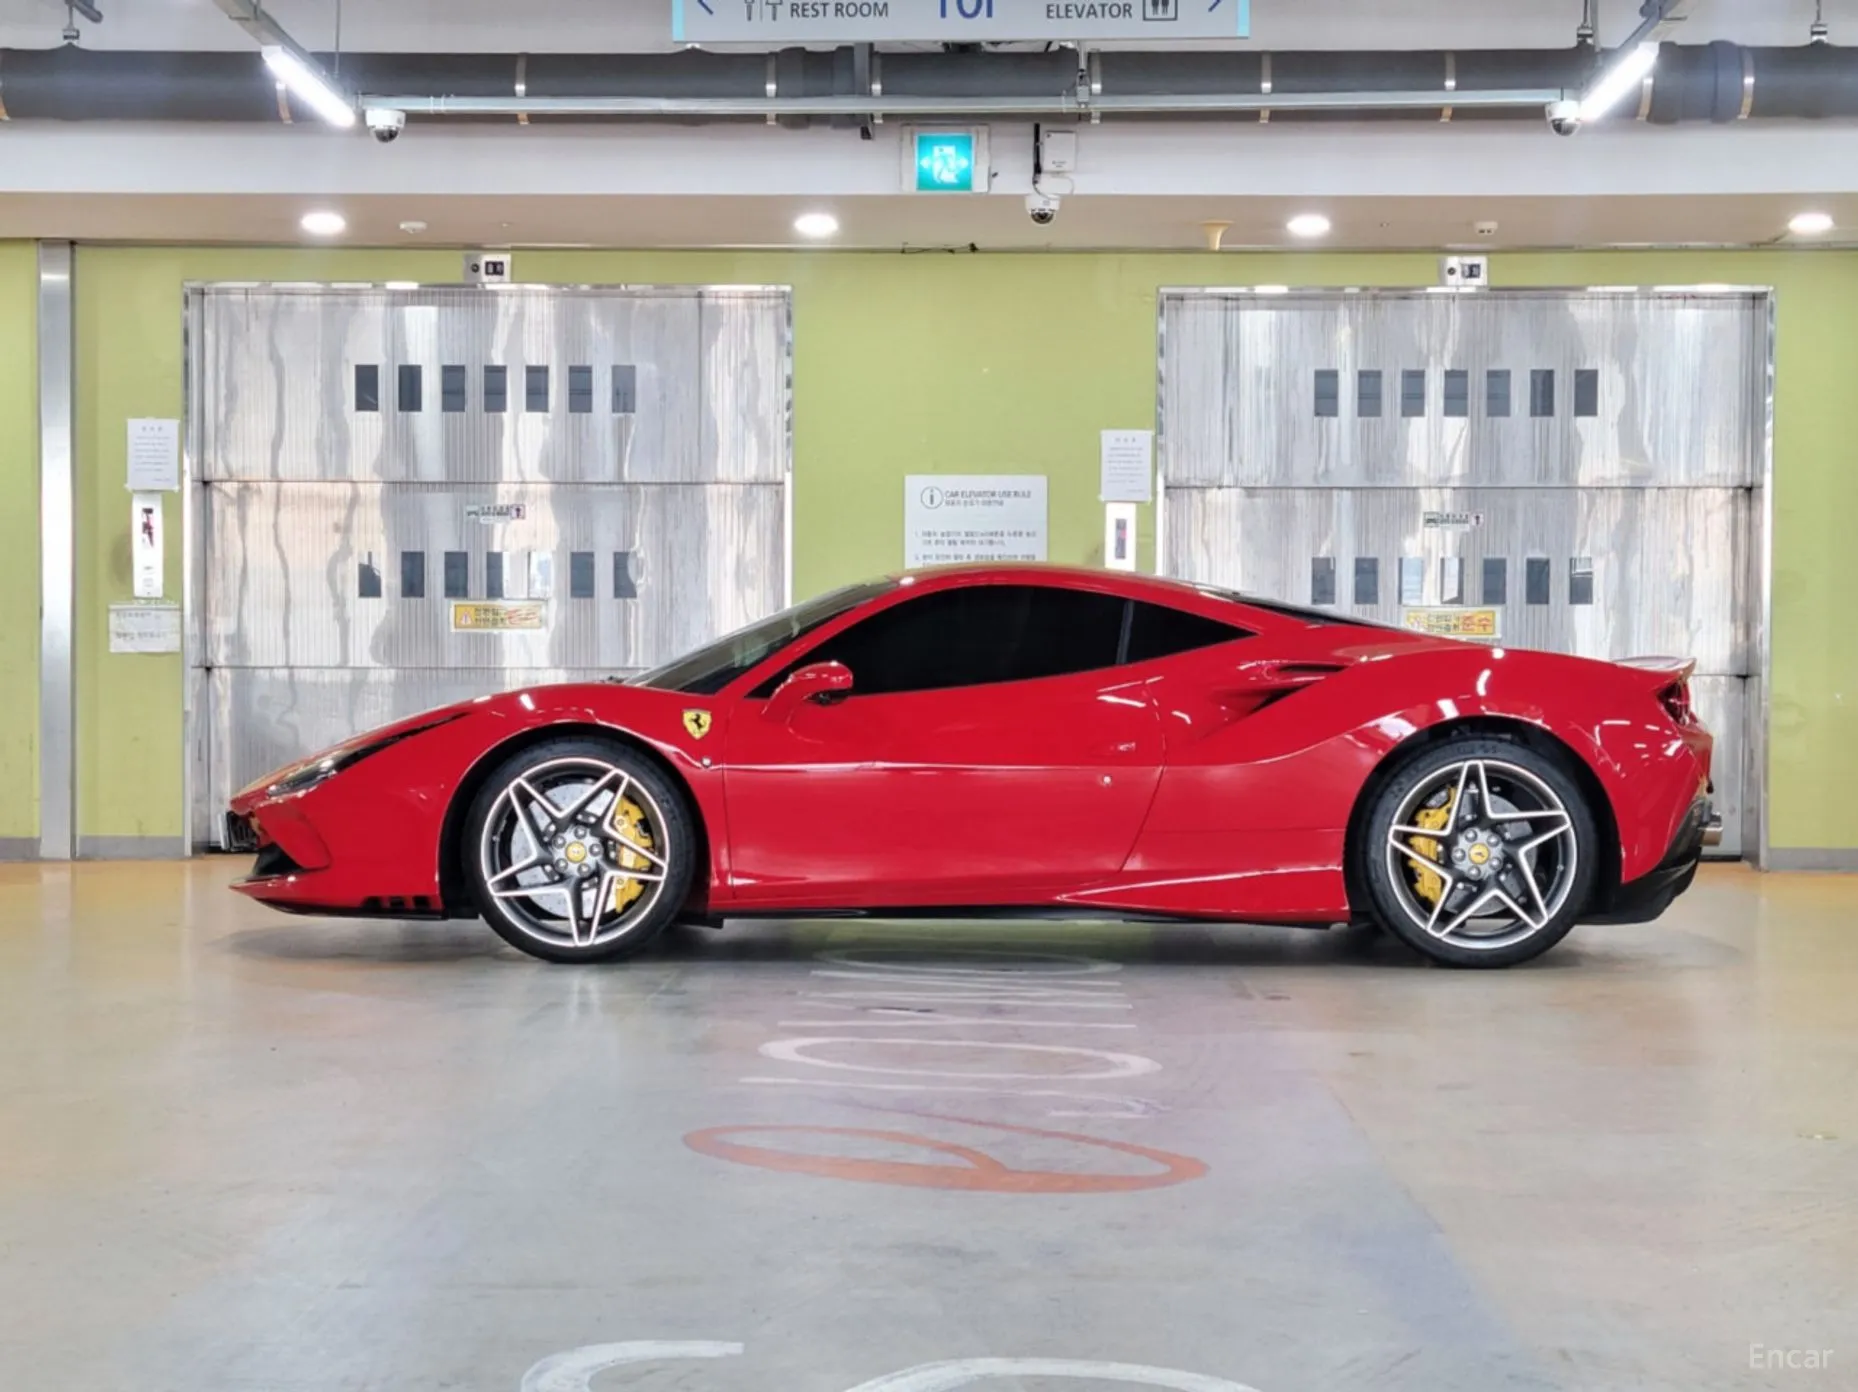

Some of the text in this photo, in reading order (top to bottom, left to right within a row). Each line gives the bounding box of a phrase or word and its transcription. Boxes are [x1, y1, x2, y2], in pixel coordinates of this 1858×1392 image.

[790, 2, 888, 18] REST ROOM
[1046, 3, 1132, 19] ELEVATOR
